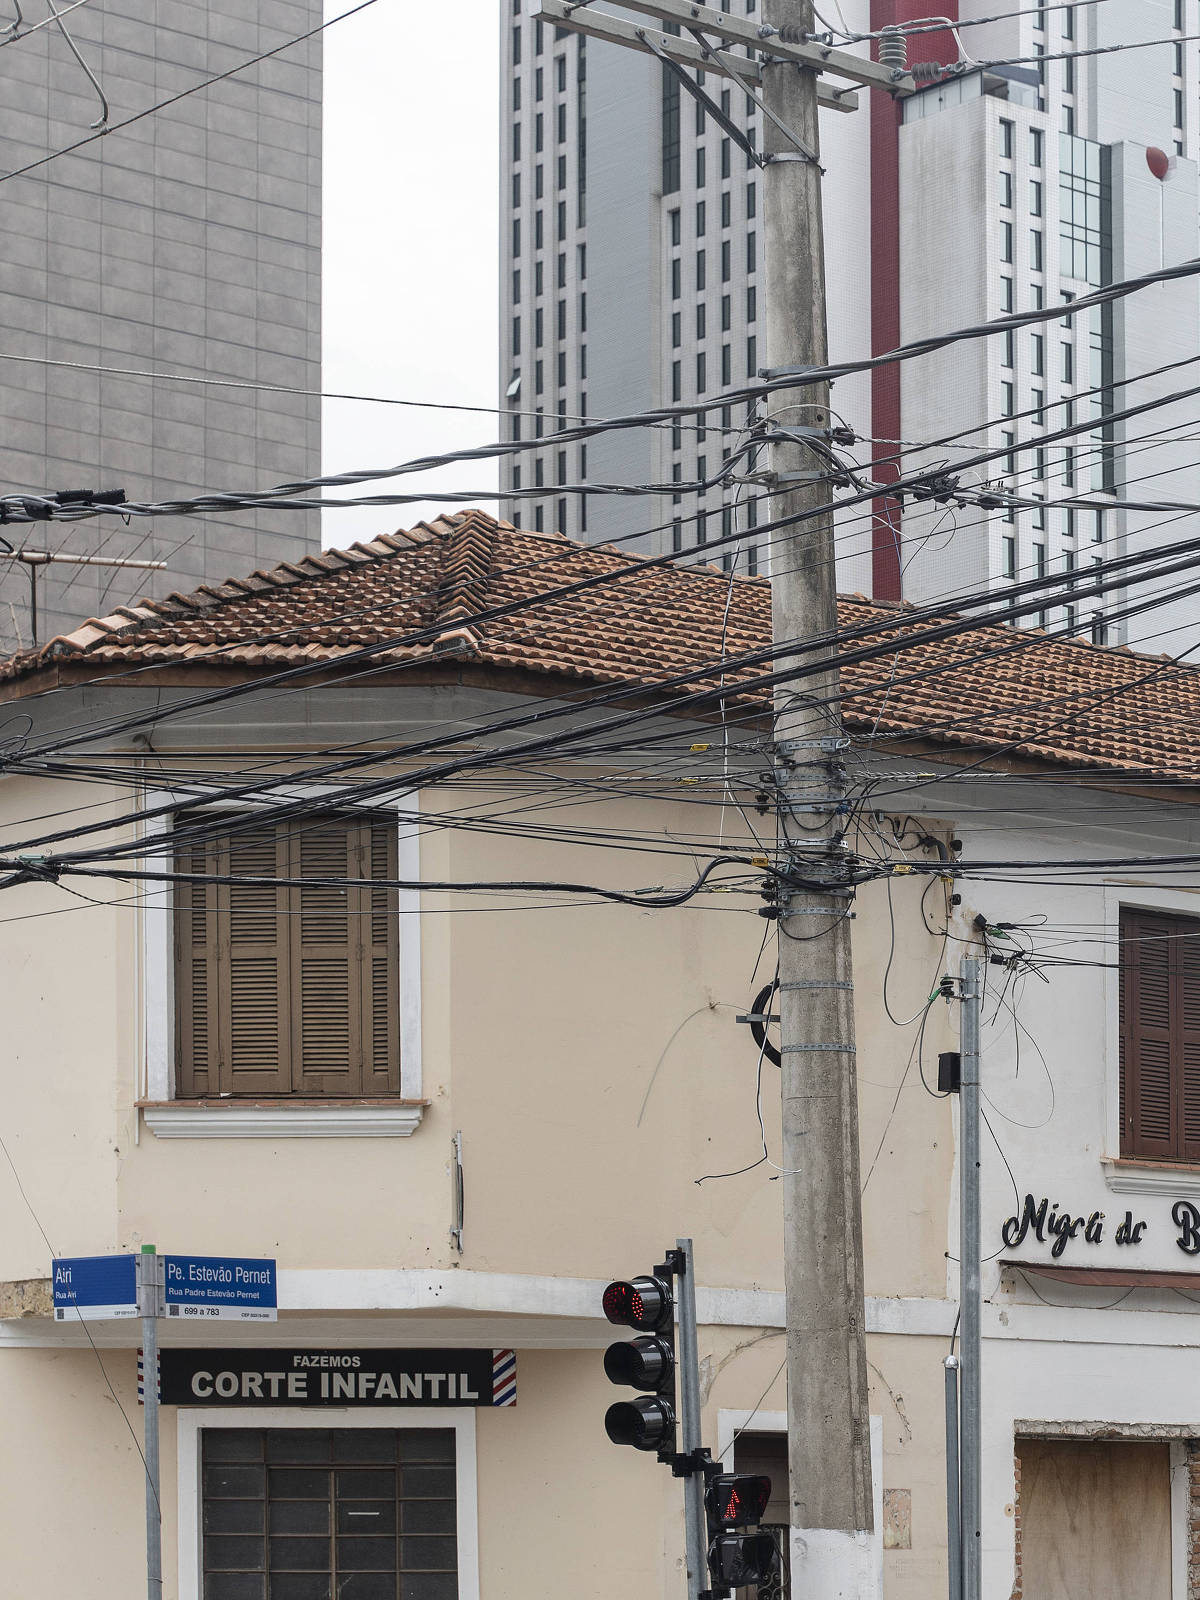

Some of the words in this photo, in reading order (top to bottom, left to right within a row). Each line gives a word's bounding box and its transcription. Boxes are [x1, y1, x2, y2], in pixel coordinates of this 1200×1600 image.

[55, 1267, 72, 1284] Airi
[168, 1263, 185, 1280] Pe.
[189, 1264, 232, 1282] Estevão
[235, 1266, 271, 1285] Pernet
[55, 1291, 67, 1299] Rua
[168, 1287, 183, 1296] Rua
[184, 1288, 205, 1297] Padre
[207, 1288, 235, 1298] Estevão
[236, 1290, 260, 1300] Pernet
[184, 1307, 198, 1316] 699
[199, 1308, 205, 1316] a
[206, 1307, 220, 1317] 783
[293, 1355, 361, 1368] FAZEMOS
[191, 1371, 308, 1399] CORTE
[320, 1372, 480, 1400] INFANTIL
